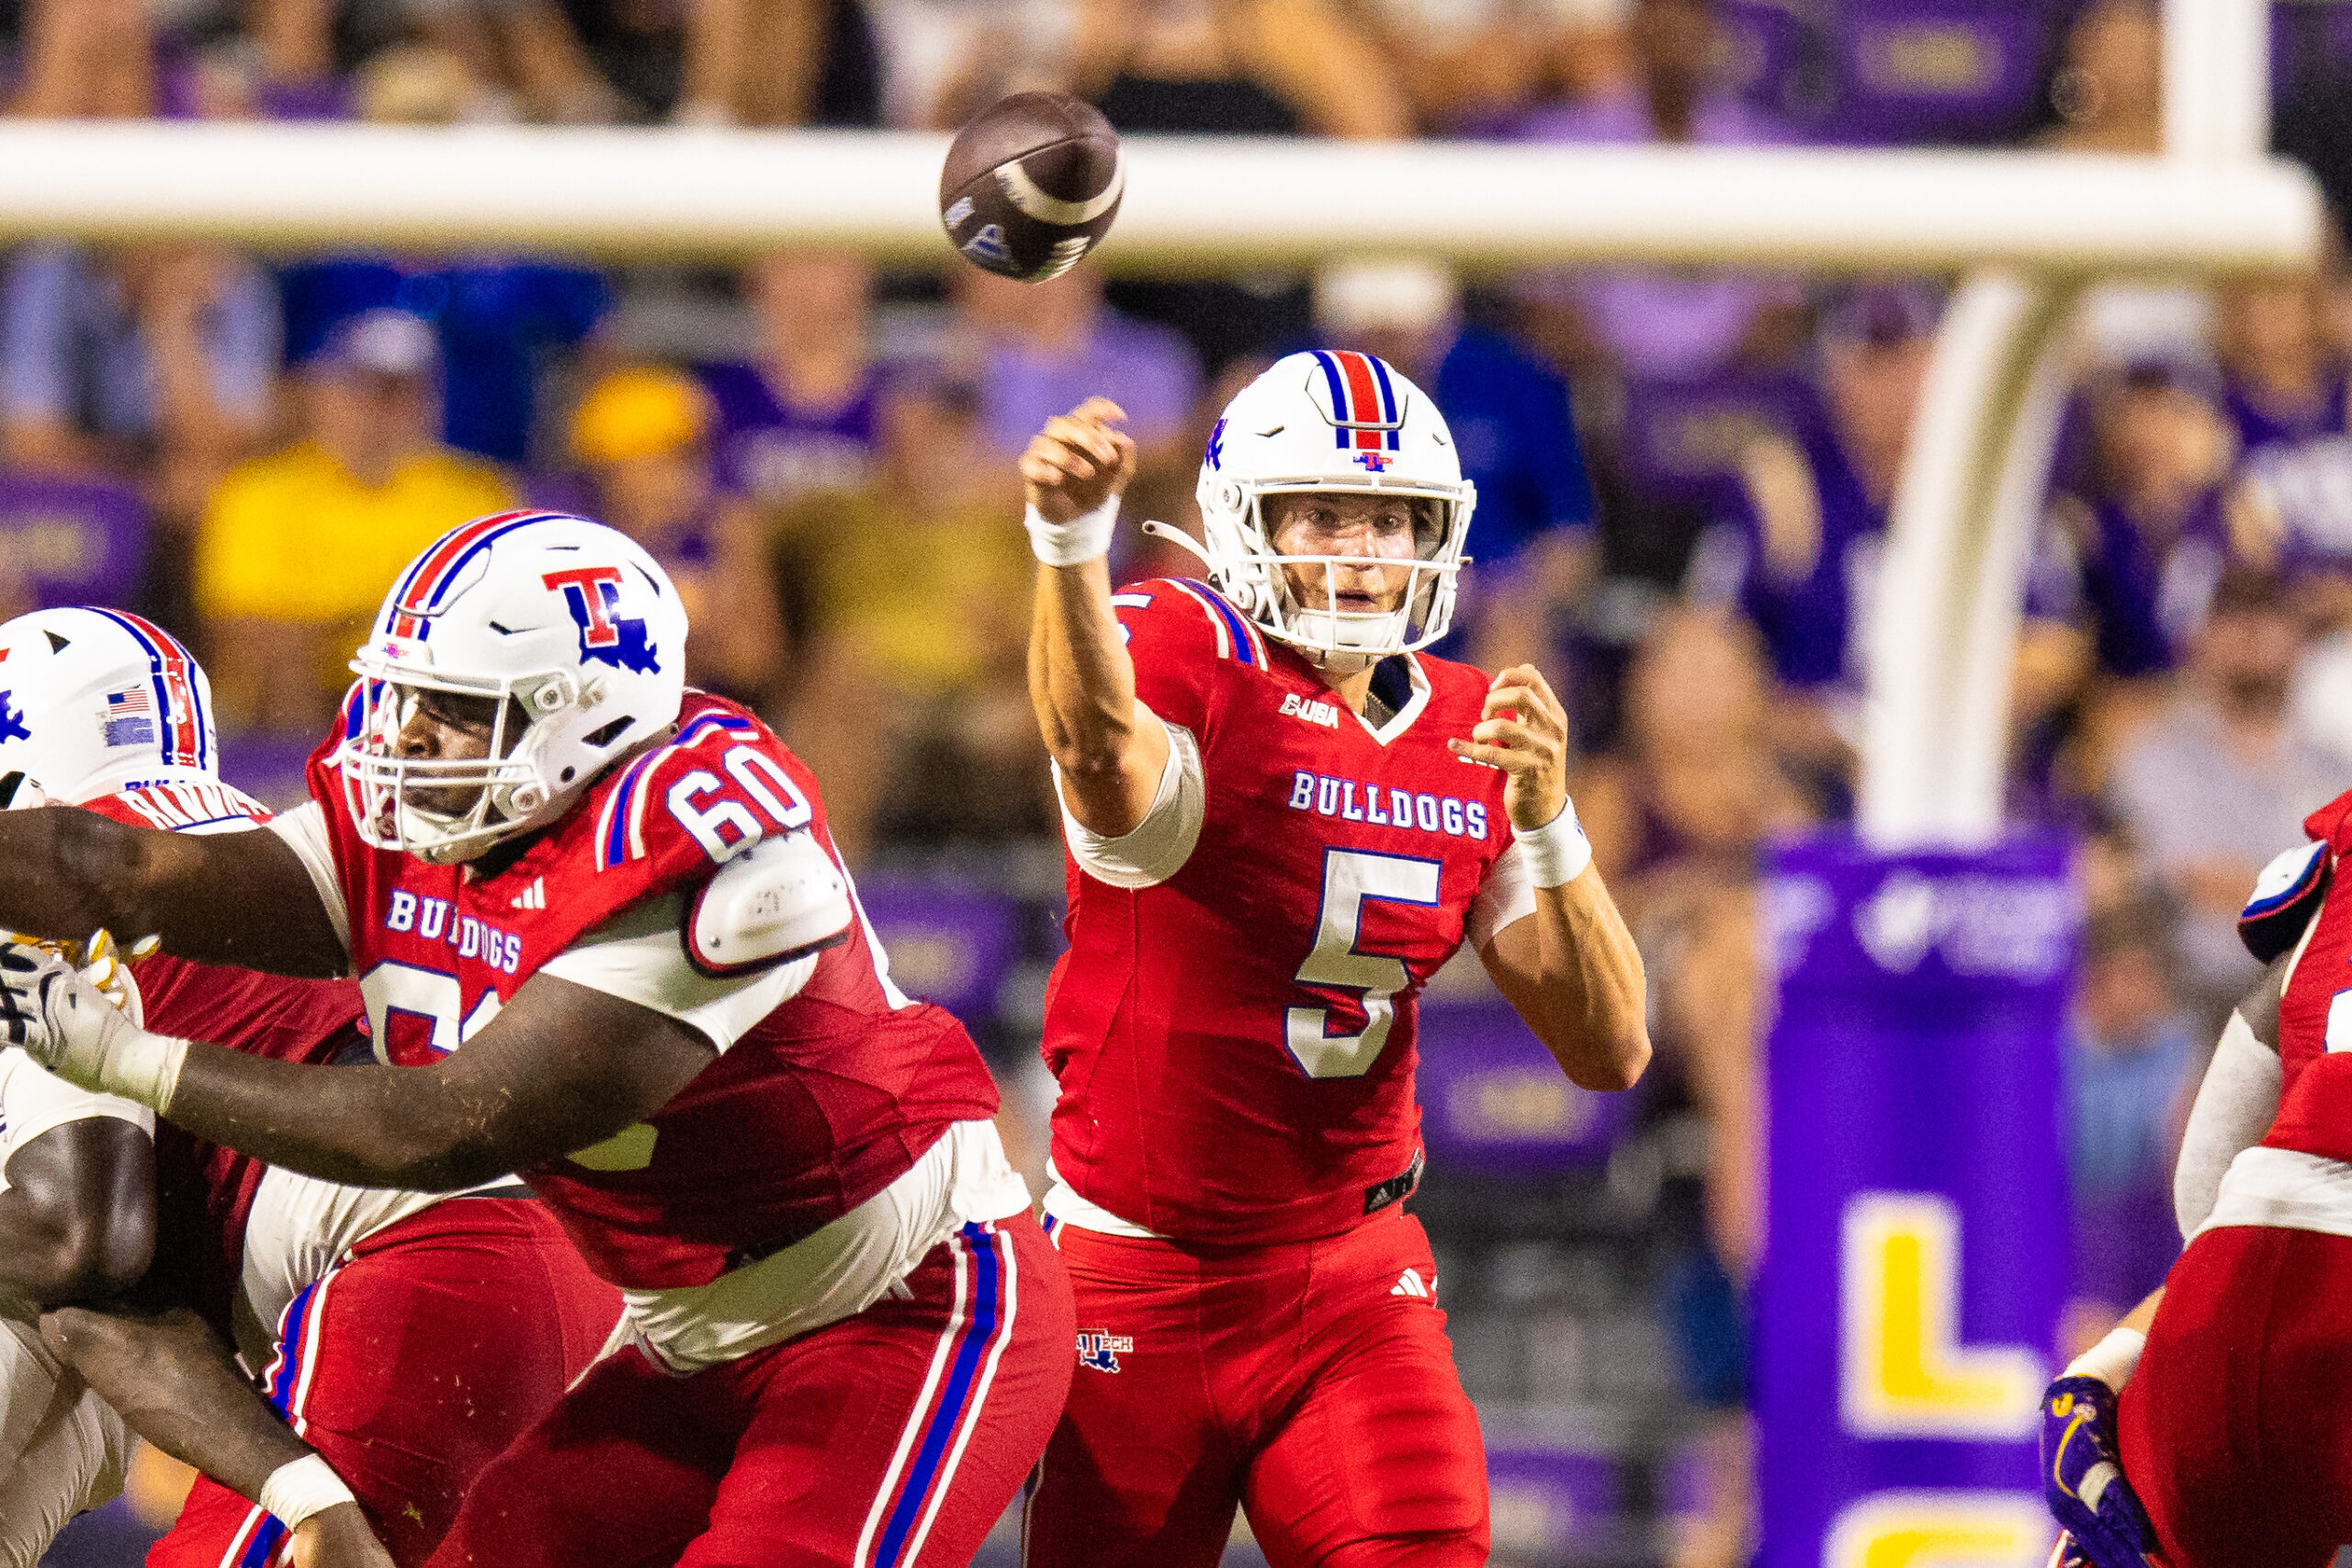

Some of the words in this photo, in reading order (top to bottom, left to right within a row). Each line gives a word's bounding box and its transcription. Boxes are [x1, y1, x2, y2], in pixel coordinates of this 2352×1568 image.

[665, 743, 813, 864] 60
[1288, 769, 1488, 840] BULLDOGS
[384, 887, 522, 976] BUDOGS
[1285, 847, 1442, 1079] 5
